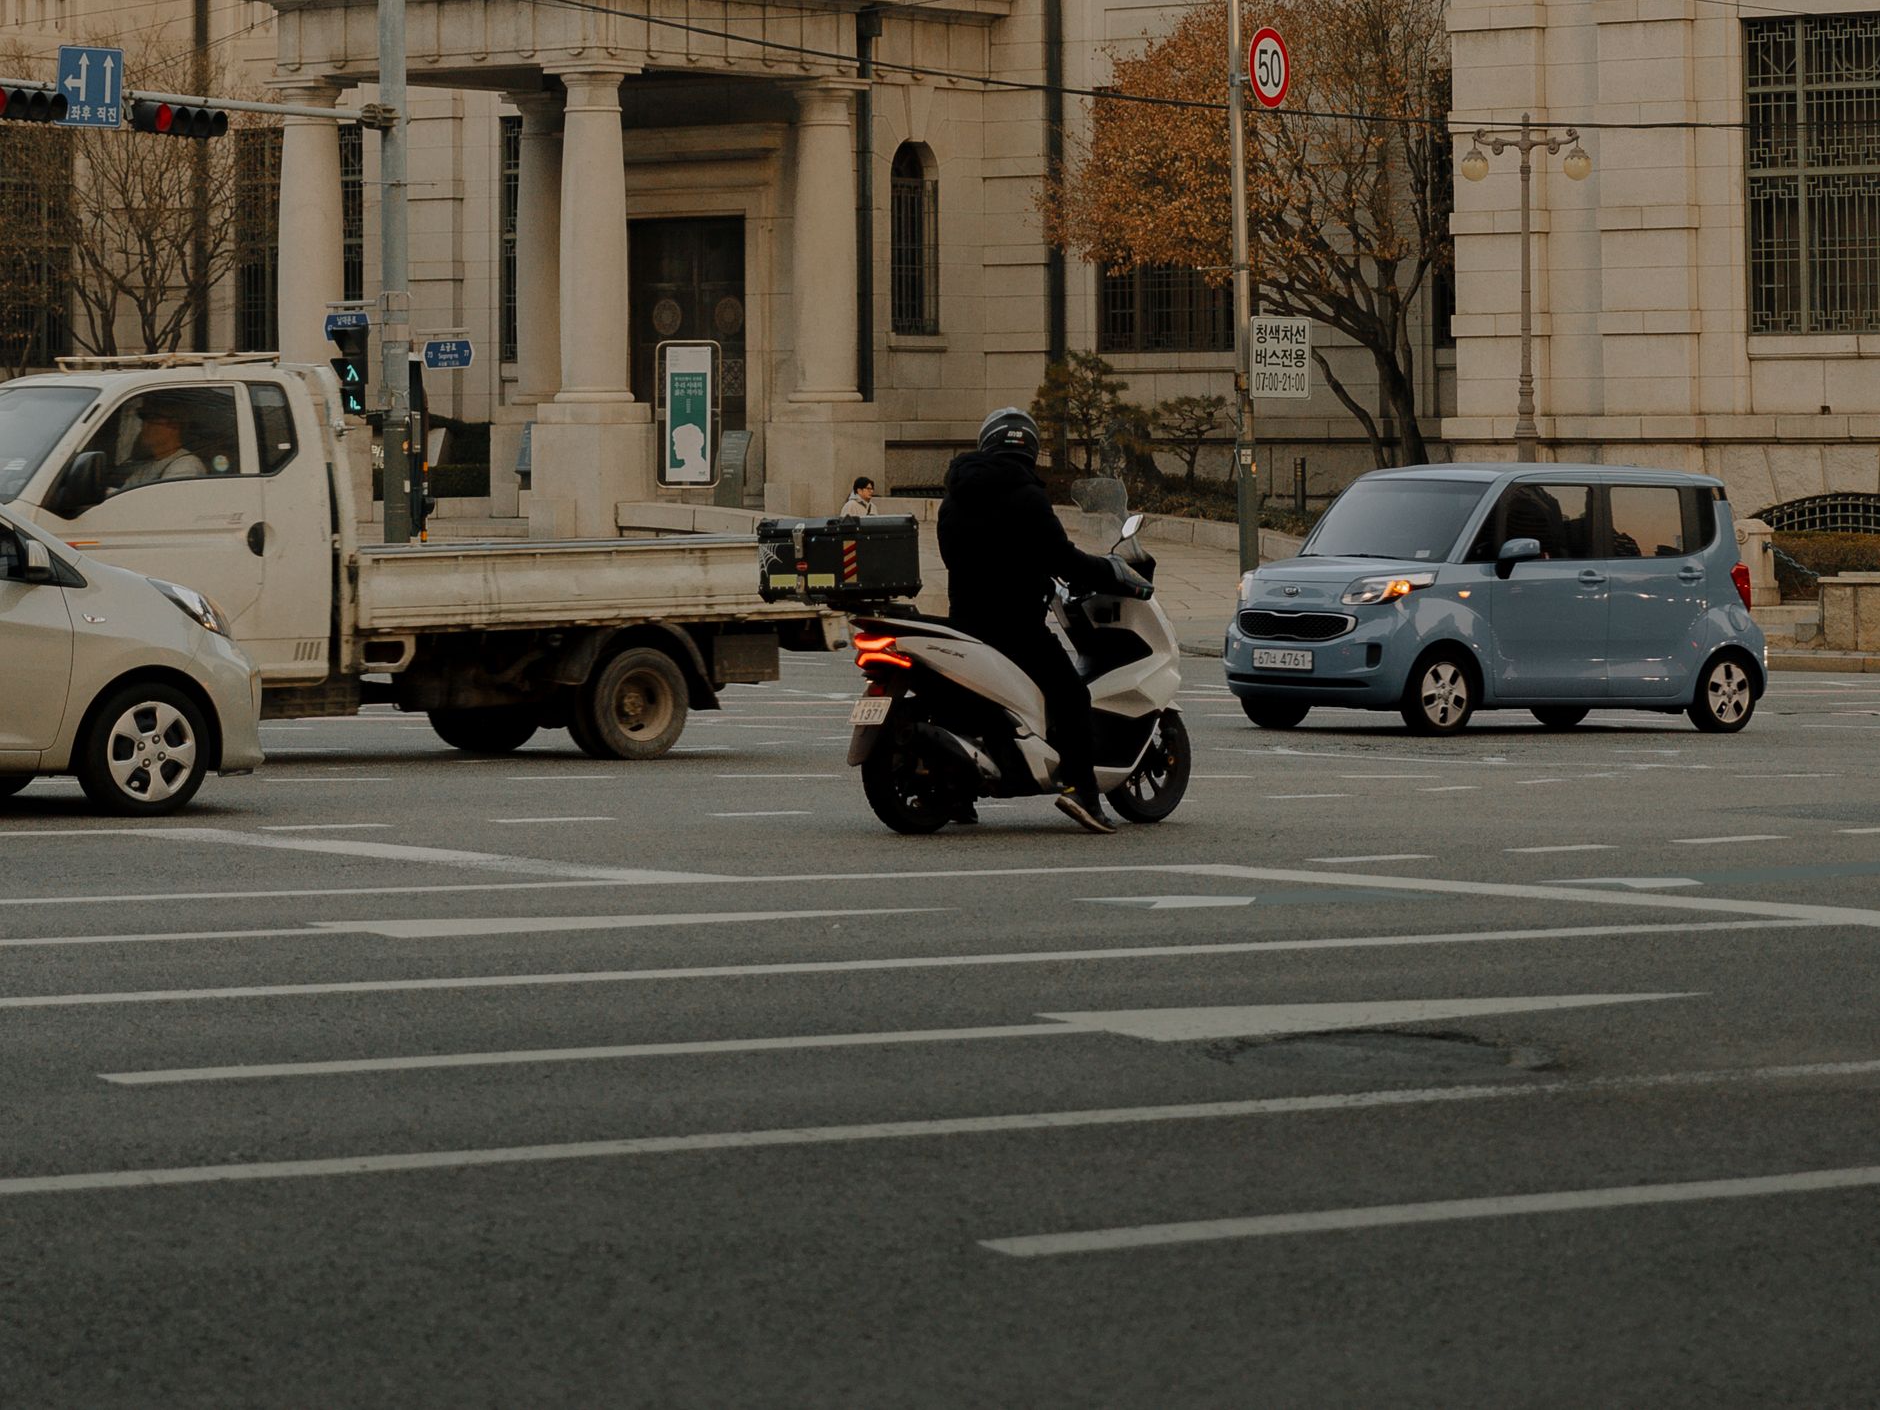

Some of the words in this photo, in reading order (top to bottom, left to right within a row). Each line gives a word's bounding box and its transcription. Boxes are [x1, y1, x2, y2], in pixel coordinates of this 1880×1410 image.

[1259, 49, 1281, 88] 50
[66, 103, 91, 121] 좌후
[97, 105, 117, 123] 직진
[1256, 324, 1306, 344] 청색차선
[1255, 348, 1306, 368] 버스전용
[1255, 372, 1305, 391] 07:00-21:00
[1280, 652, 1306, 667] 4761
[860, 708, 884, 721] 1371
